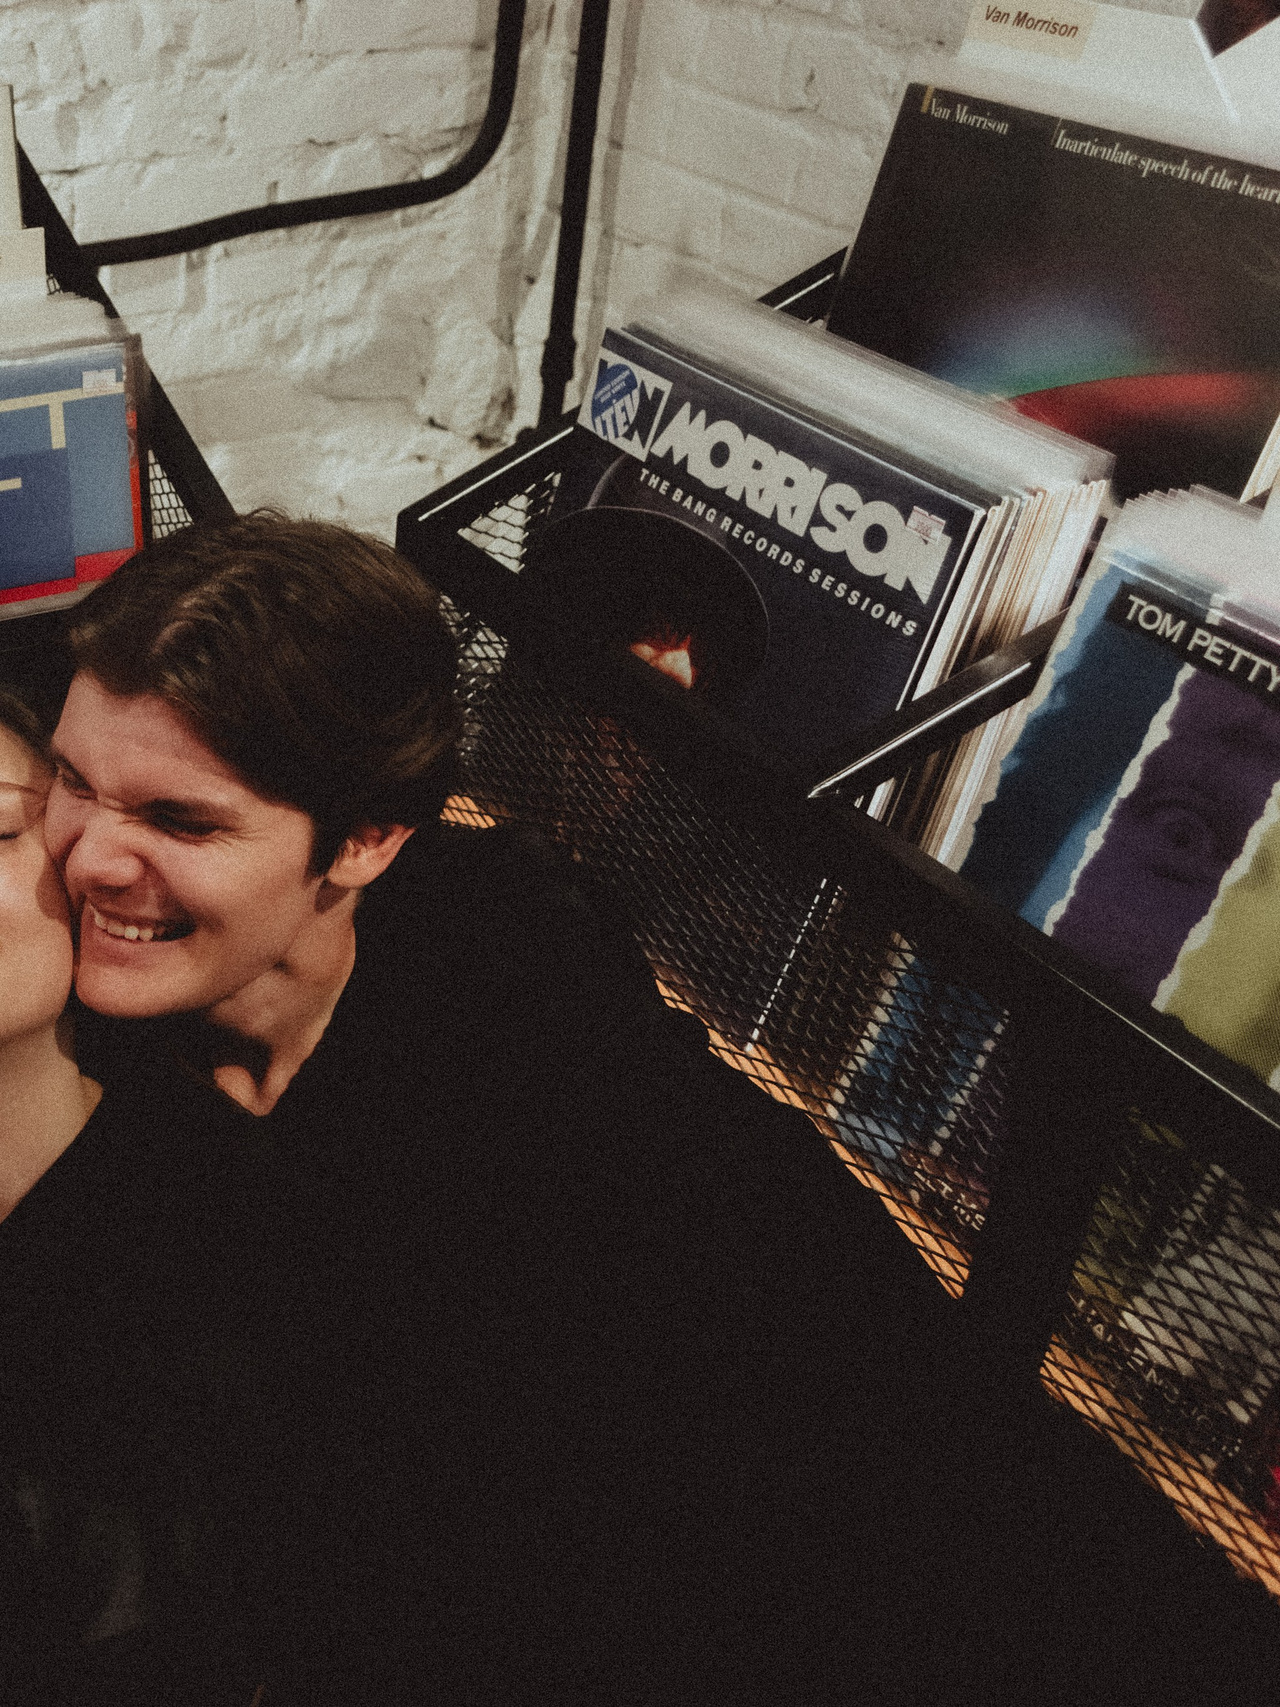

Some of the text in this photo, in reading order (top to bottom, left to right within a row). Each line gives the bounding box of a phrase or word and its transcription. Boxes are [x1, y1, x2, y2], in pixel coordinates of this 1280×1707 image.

[984, 4, 1080, 39] Van Morrison
[954, 102, 1010, 135] Morrison
[1054, 128, 1138, 168] Inarticulate
[1138, 154, 1190, 181] speech
[1191, 164, 1214, 185] of
[1211, 169, 1240, 193] the
[649, 401, 953, 605] MORRISON
[639, 467, 919, 638] THE BANG RECORDS SESSIONS
[1126, 594, 1187, 644] TOM
